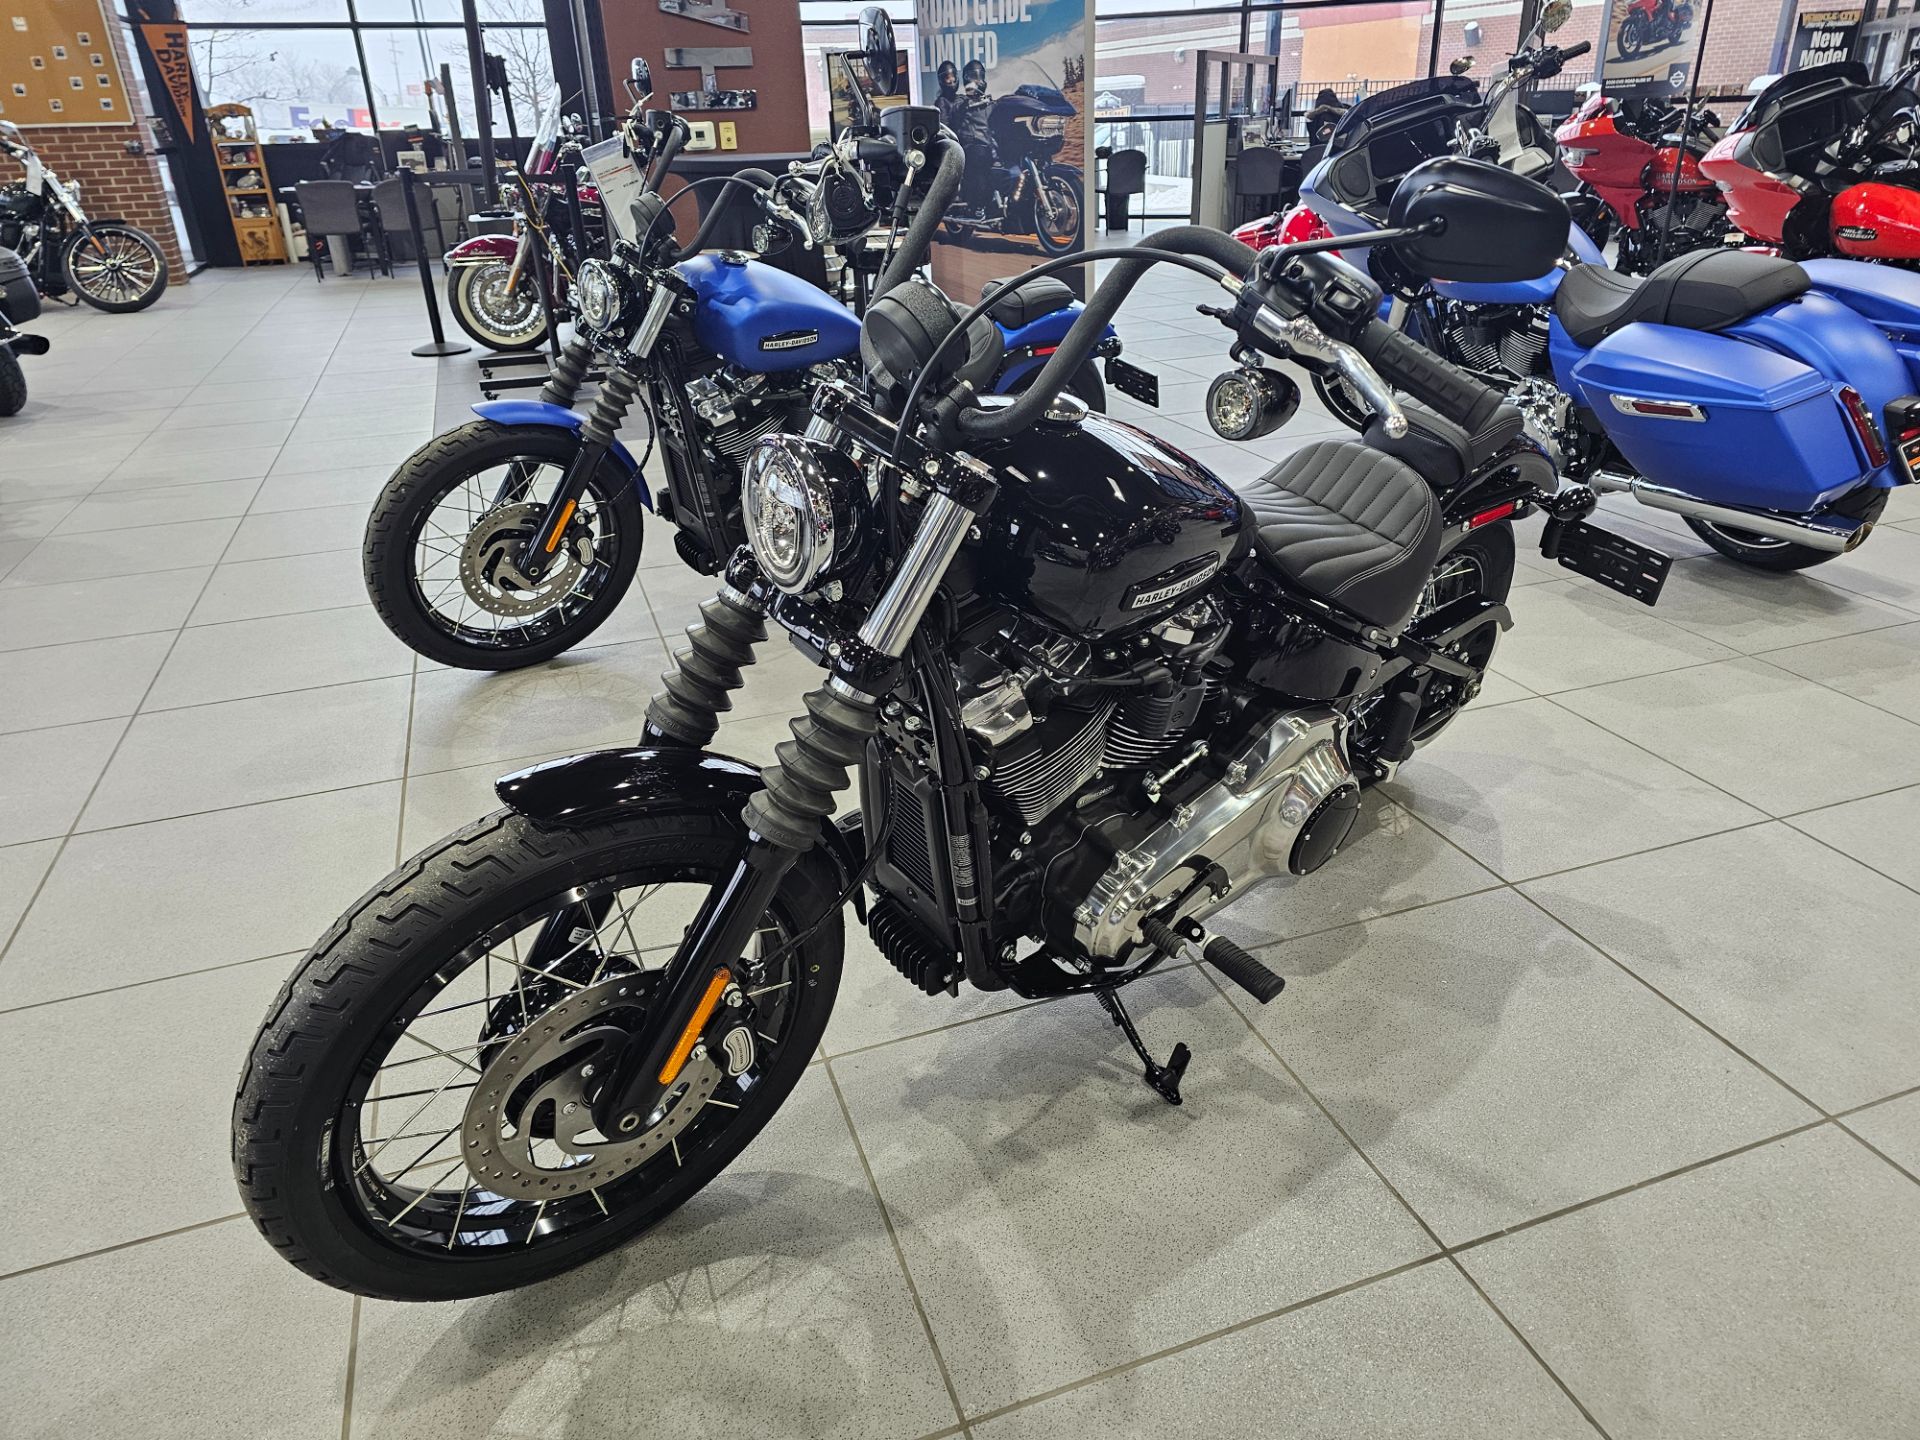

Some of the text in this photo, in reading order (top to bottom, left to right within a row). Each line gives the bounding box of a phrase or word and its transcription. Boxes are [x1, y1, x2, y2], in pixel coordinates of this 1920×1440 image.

[918, 0, 1032, 28] ROAD GLIDE
[1810, 31, 1845, 48] New
[920, 31, 999, 72] LIMITED
[1799, 48, 1848, 67] Model
[764, 335, 817, 349] HARLEY-DAVIDSON
[1135, 563, 1216, 606] HARLEY-DAVIDSON
